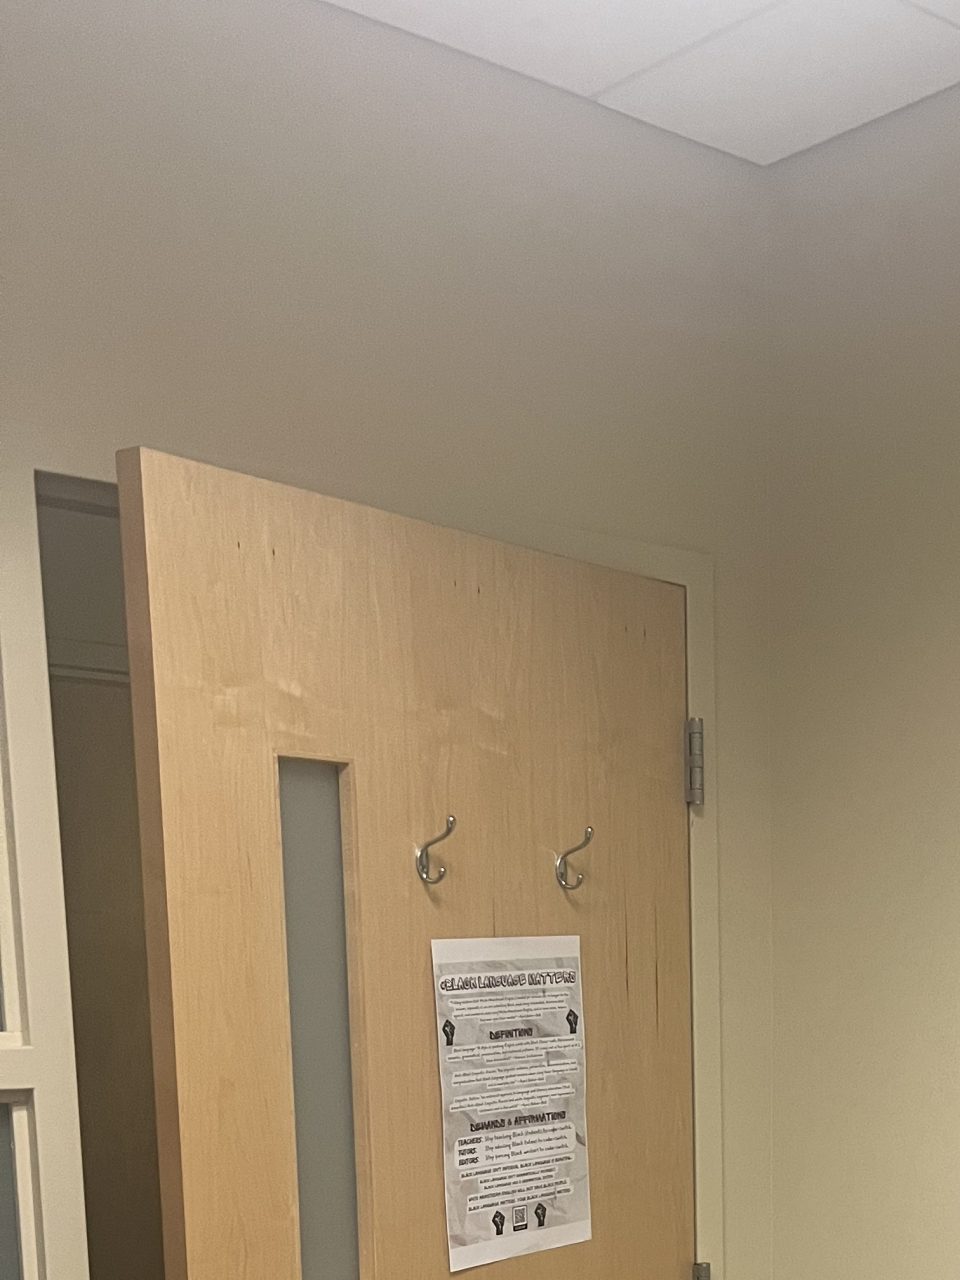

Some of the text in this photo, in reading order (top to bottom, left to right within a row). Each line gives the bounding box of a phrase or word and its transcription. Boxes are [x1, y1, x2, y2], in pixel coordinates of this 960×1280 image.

[478, 973, 527, 989] LANGUAGE
[528, 971, 577, 986] MATTERS
[470, 1118, 506, 1132] DEMANDS
[514, 1110, 567, 1126] AFFIRMATIONS
